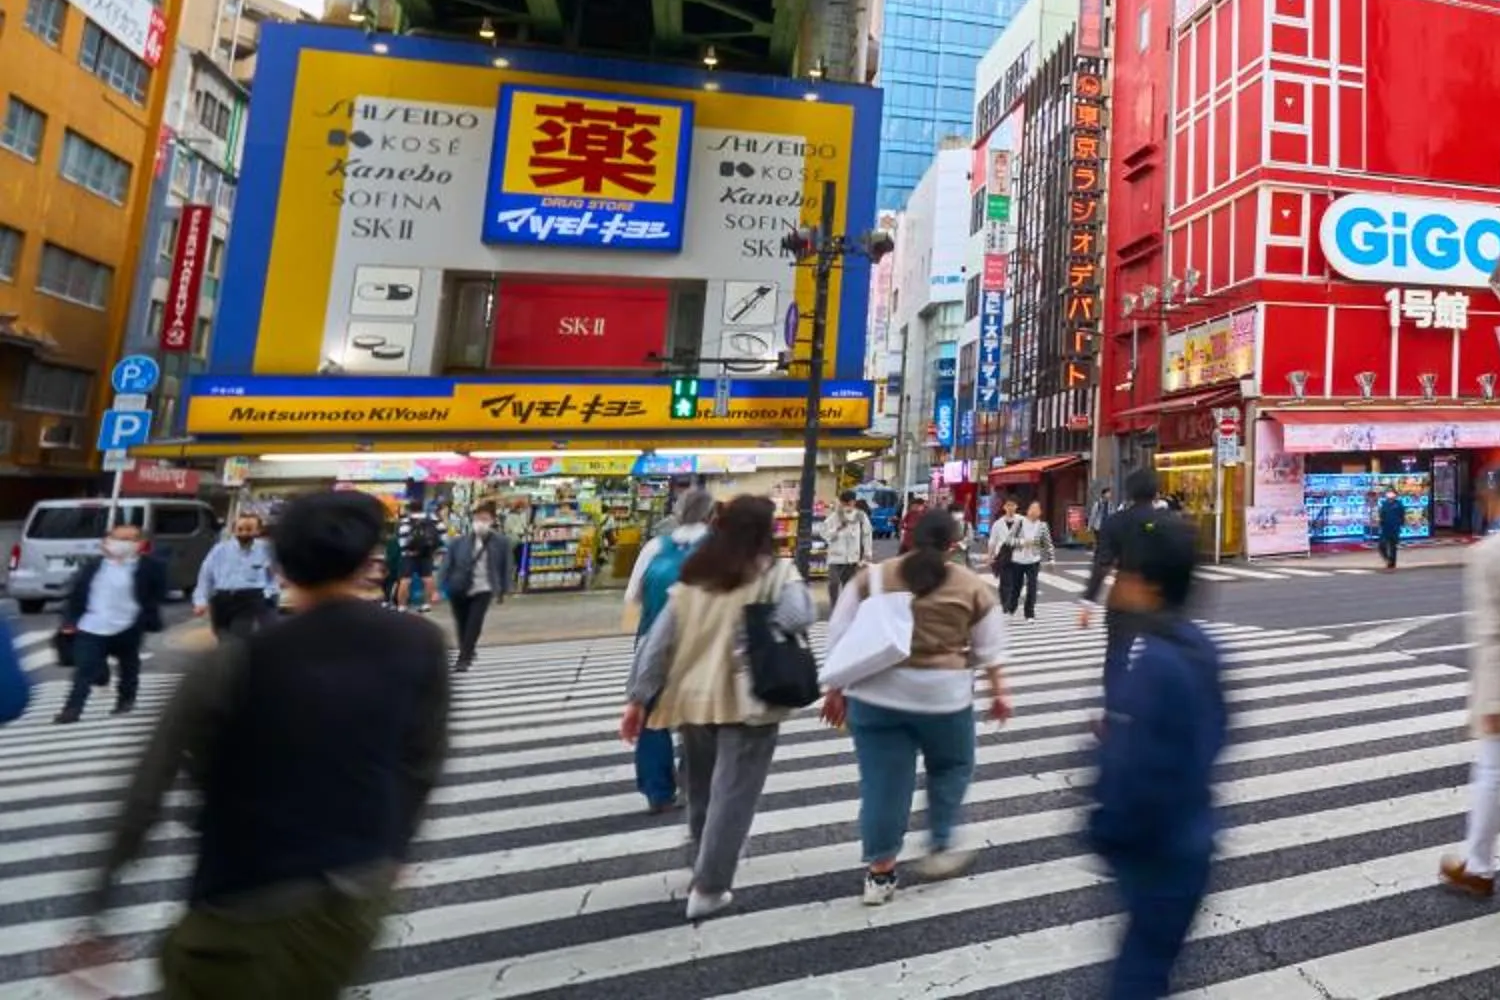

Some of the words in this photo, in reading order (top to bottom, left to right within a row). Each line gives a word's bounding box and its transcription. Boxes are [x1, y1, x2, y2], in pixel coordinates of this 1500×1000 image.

[313, 100, 480, 130] SHISEIDO
[380, 137, 461, 156] KOSÉ
[528, 101, 663, 195] 薬
[706, 136, 837, 160] SHISEIDO
[325, 158, 454, 186] Kanebo
[331, 190, 442, 212] SOFINA
[541, 196, 590, 211] DRUG
[597, 199, 635, 212] STORE
[718, 186, 818, 209] Kanebo
[496, 206, 671, 243] マツモトキヨシ
[1067, 104, 1099, 385] 東京ラジオデパート
[1384, 288, 1469, 330] 1号館
[121, 365, 140, 389] P
[229, 407, 362, 422] Matsumoto
[367, 406, 449, 422] KiYoshi
[481, 394, 648, 423] マツモトキヨシ
[111, 415, 141, 446] P
[479, 463, 529, 478] SALE
